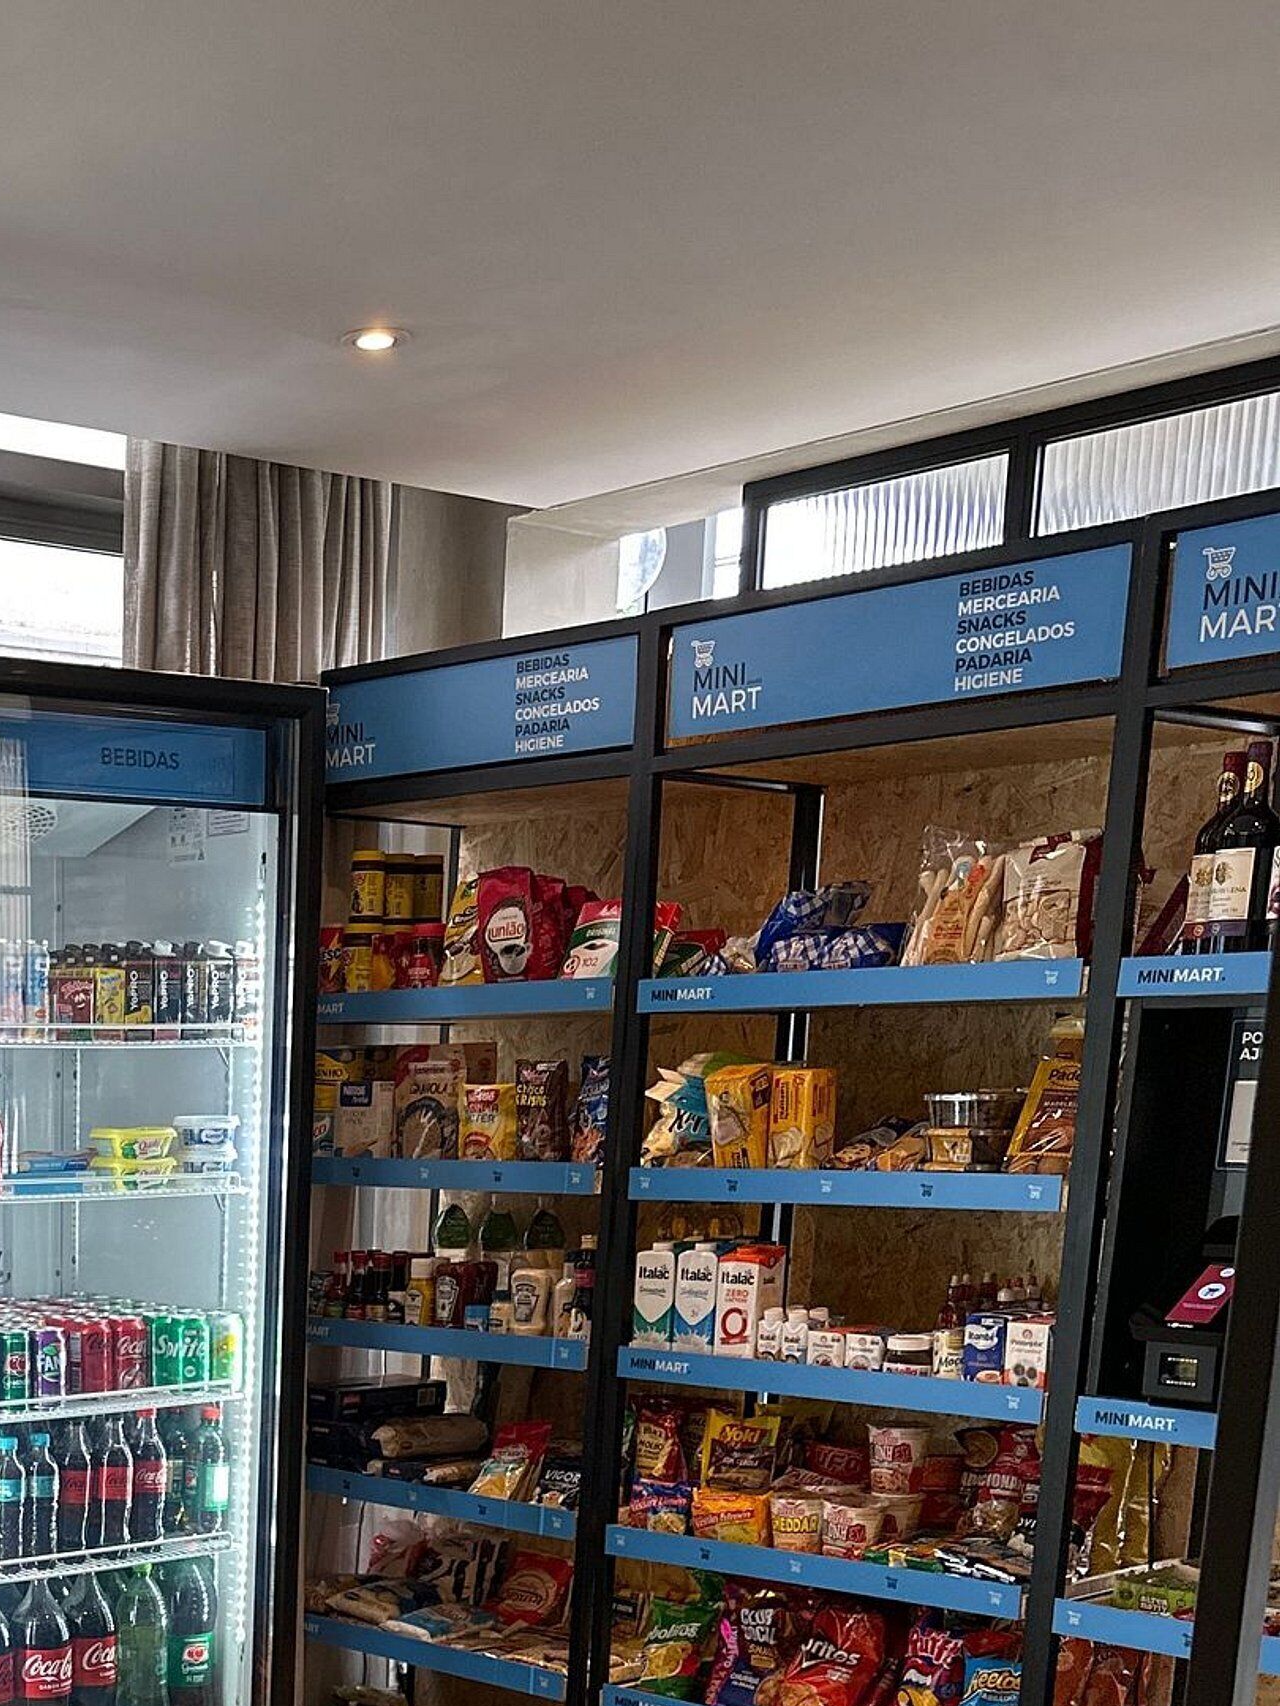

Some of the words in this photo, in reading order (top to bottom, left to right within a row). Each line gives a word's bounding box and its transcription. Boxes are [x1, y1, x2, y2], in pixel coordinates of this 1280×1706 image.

[959, 570, 1035, 597] BEBIDAS
[1203, 571, 1278, 611] MINI
[957, 585, 1060, 616] MERCEARIA
[956, 611, 1026, 635] SNACKS
[1200, 603, 1280, 642] MAR
[955, 621, 1075, 654] CONGELADOS
[516, 653, 570, 674] BEBIDAS
[955, 648, 1032, 673] PADARIA
[515, 666, 589, 690] MERCEARIA
[693, 661, 747, 693] MINI
[954, 668, 1024, 692] HIGIENE
[515, 686, 566, 706] SNACKS
[691, 686, 763, 719] MART
[515, 696, 600, 721] CONGELADOS
[326, 721, 365, 746] MINI
[514, 717, 570, 738] PADARIA
[325, 743, 376, 769] MART
[514, 734, 565, 754] HIGIENE
[101, 746, 181, 770] BEBIDAS
[638, 1265, 670, 1280] Italac
[680, 1266, 713, 1283] Italac
[721, 1270, 755, 1286] Italac
[156, 1334, 207, 1360] Sprite
[722, 1424, 760, 1443] Yoki
[544, 1468, 582, 1484] VIGOR
